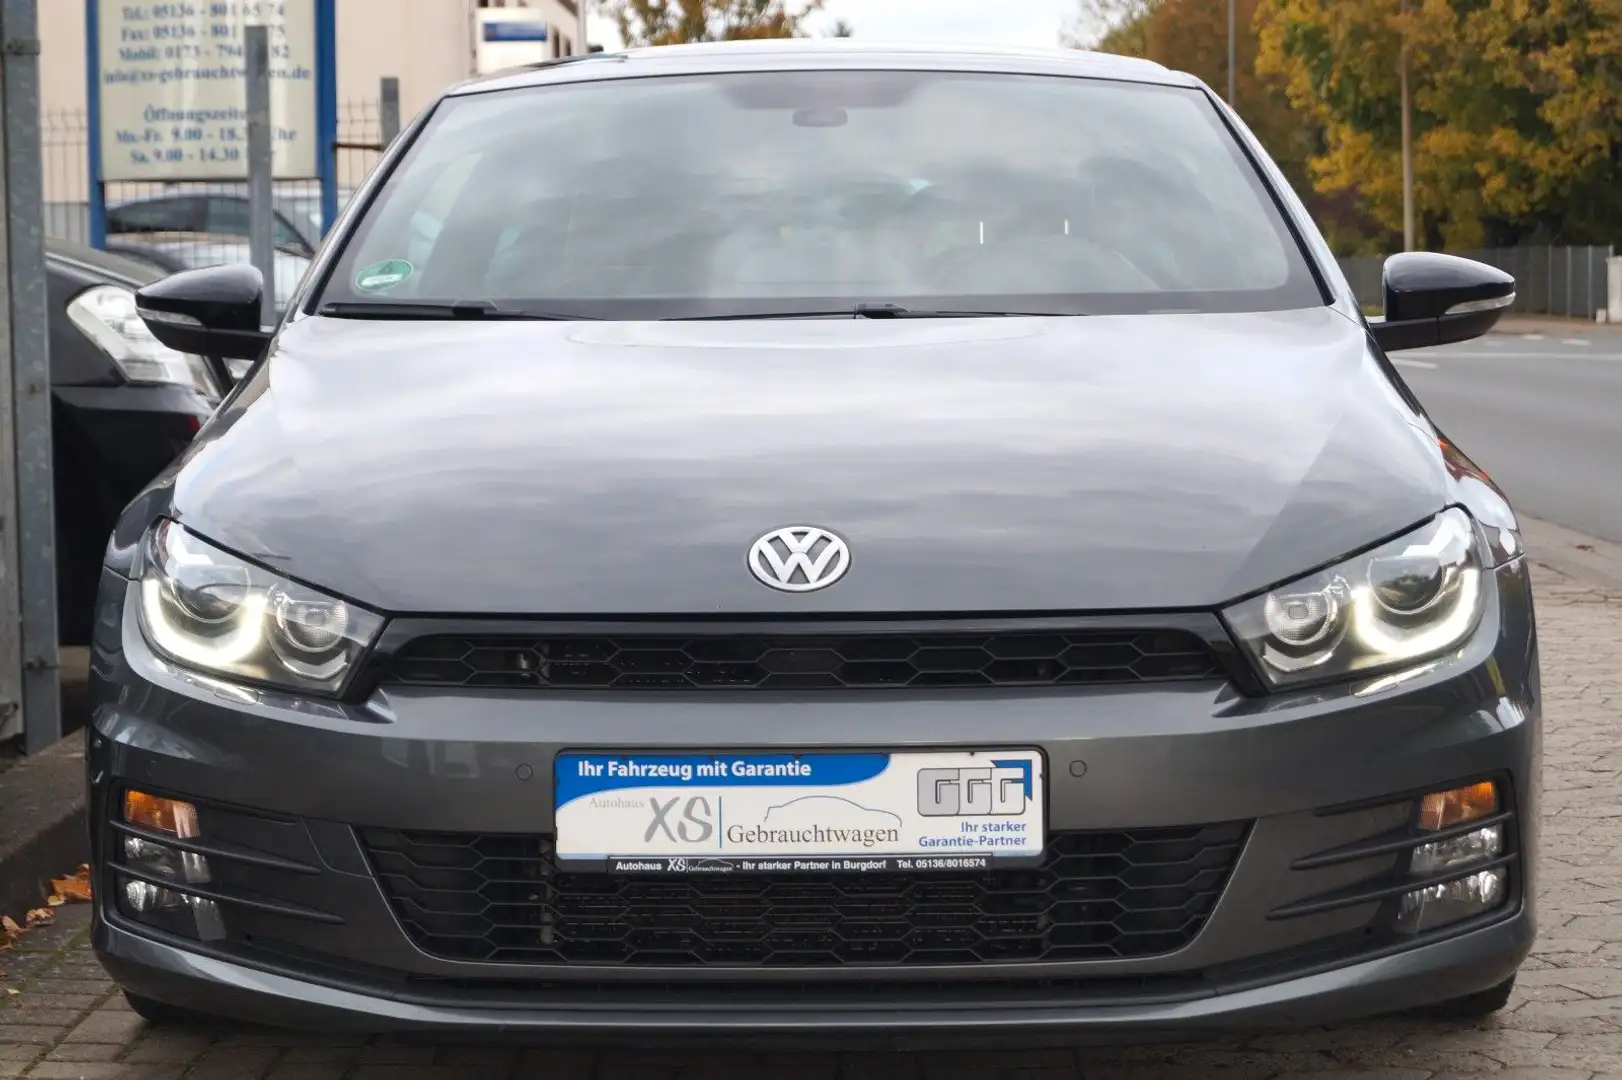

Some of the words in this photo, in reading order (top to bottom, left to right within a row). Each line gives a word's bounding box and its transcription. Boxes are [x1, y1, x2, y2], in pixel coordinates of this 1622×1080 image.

[152, 4, 195, 18] 05136
[152, 25, 196, 38] 05136
[578, 760, 602, 777] Ihr
[608, 760, 692, 781] Fahrzeug
[696, 760, 727, 777] mit
[731, 760, 812, 777] Garantie
[589, 796, 645, 809] Autohaus
[644, 796, 713, 843] XS
[961, 821, 978, 833] Ihr
[982, 821, 1026, 832] starker
[727, 824, 899, 846] Gebrauchtwagen
[918, 834, 1027, 848] Garantie-Partner
[615, 861, 662, 871] Autohaus
[742, 861, 756, 870] Ihr
[758, 861, 790, 870] starker
[794, 860, 829, 870] Partner
[831, 861, 841, 869] in
[843, 860, 887, 871] Burgdorf
[897, 860, 914, 869] Tel.
[915, 858, 987, 869] 05136/8016574
